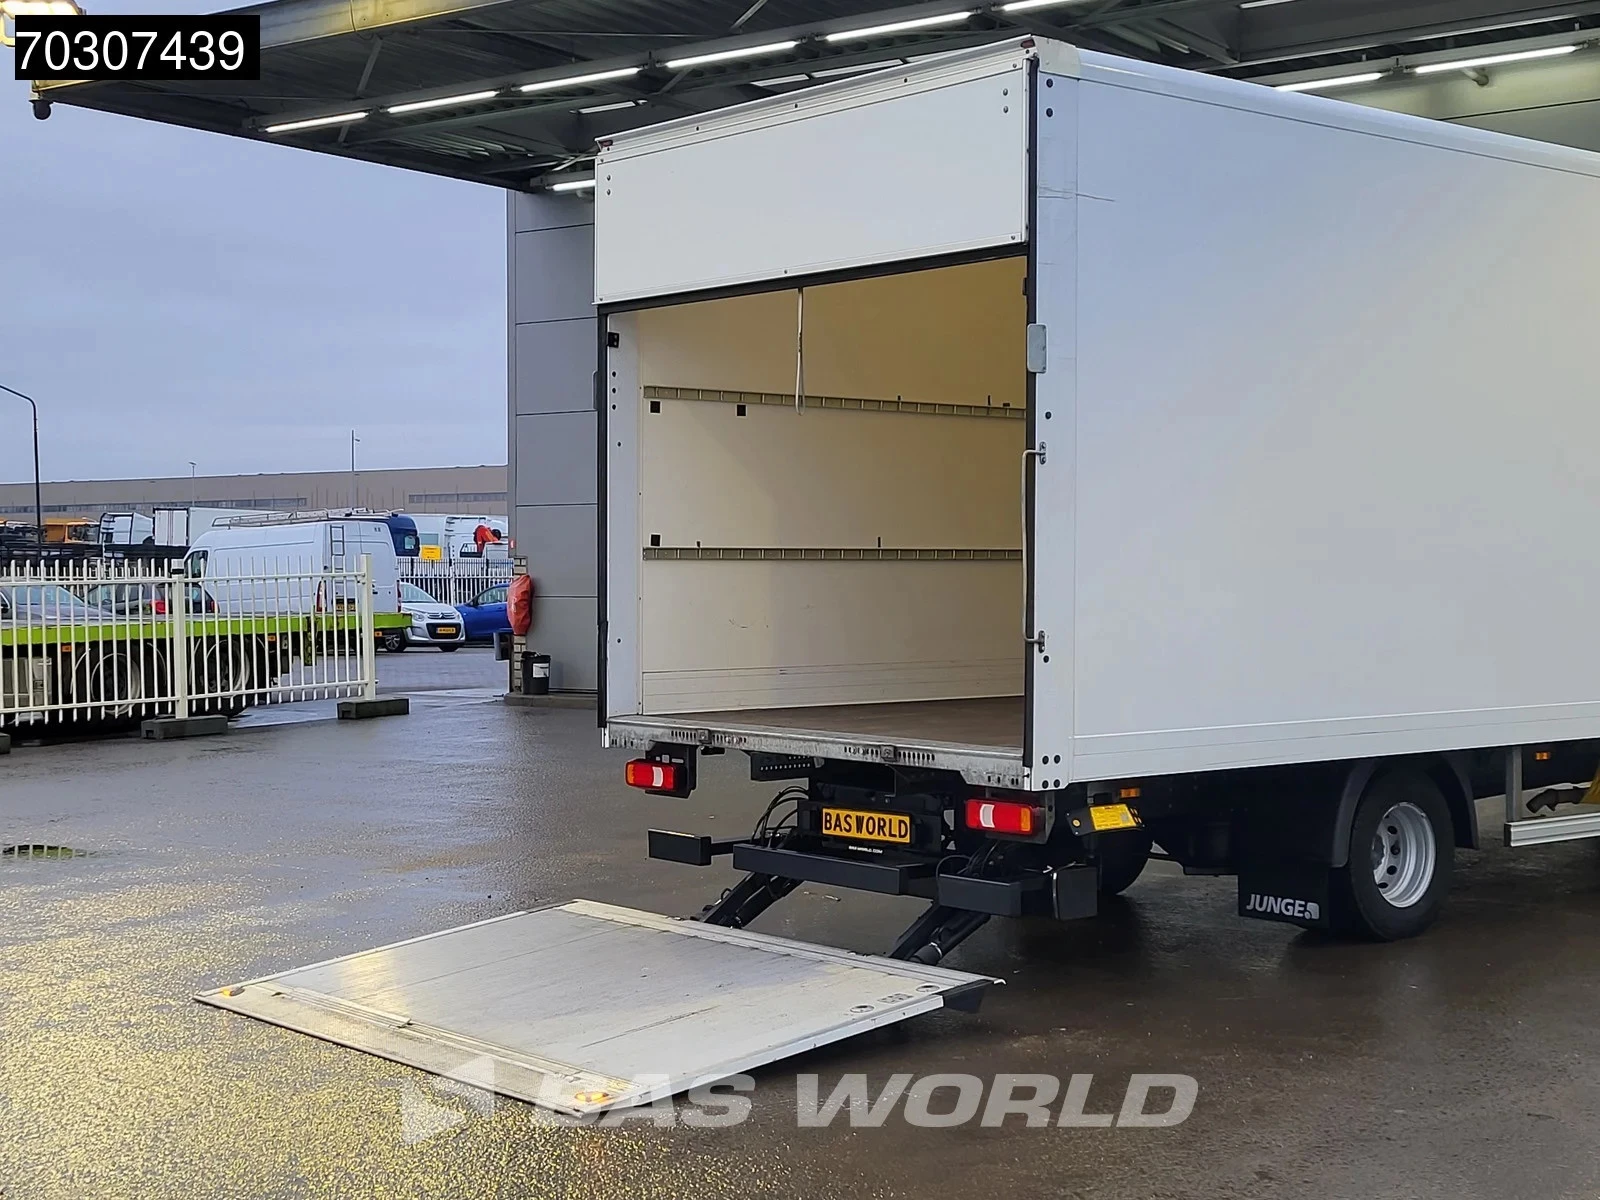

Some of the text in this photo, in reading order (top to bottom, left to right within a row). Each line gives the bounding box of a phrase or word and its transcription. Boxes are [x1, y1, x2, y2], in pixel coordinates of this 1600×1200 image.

[824, 812, 908, 839] BAS WORLD
[1246, 893, 1306, 917] JUNGE
